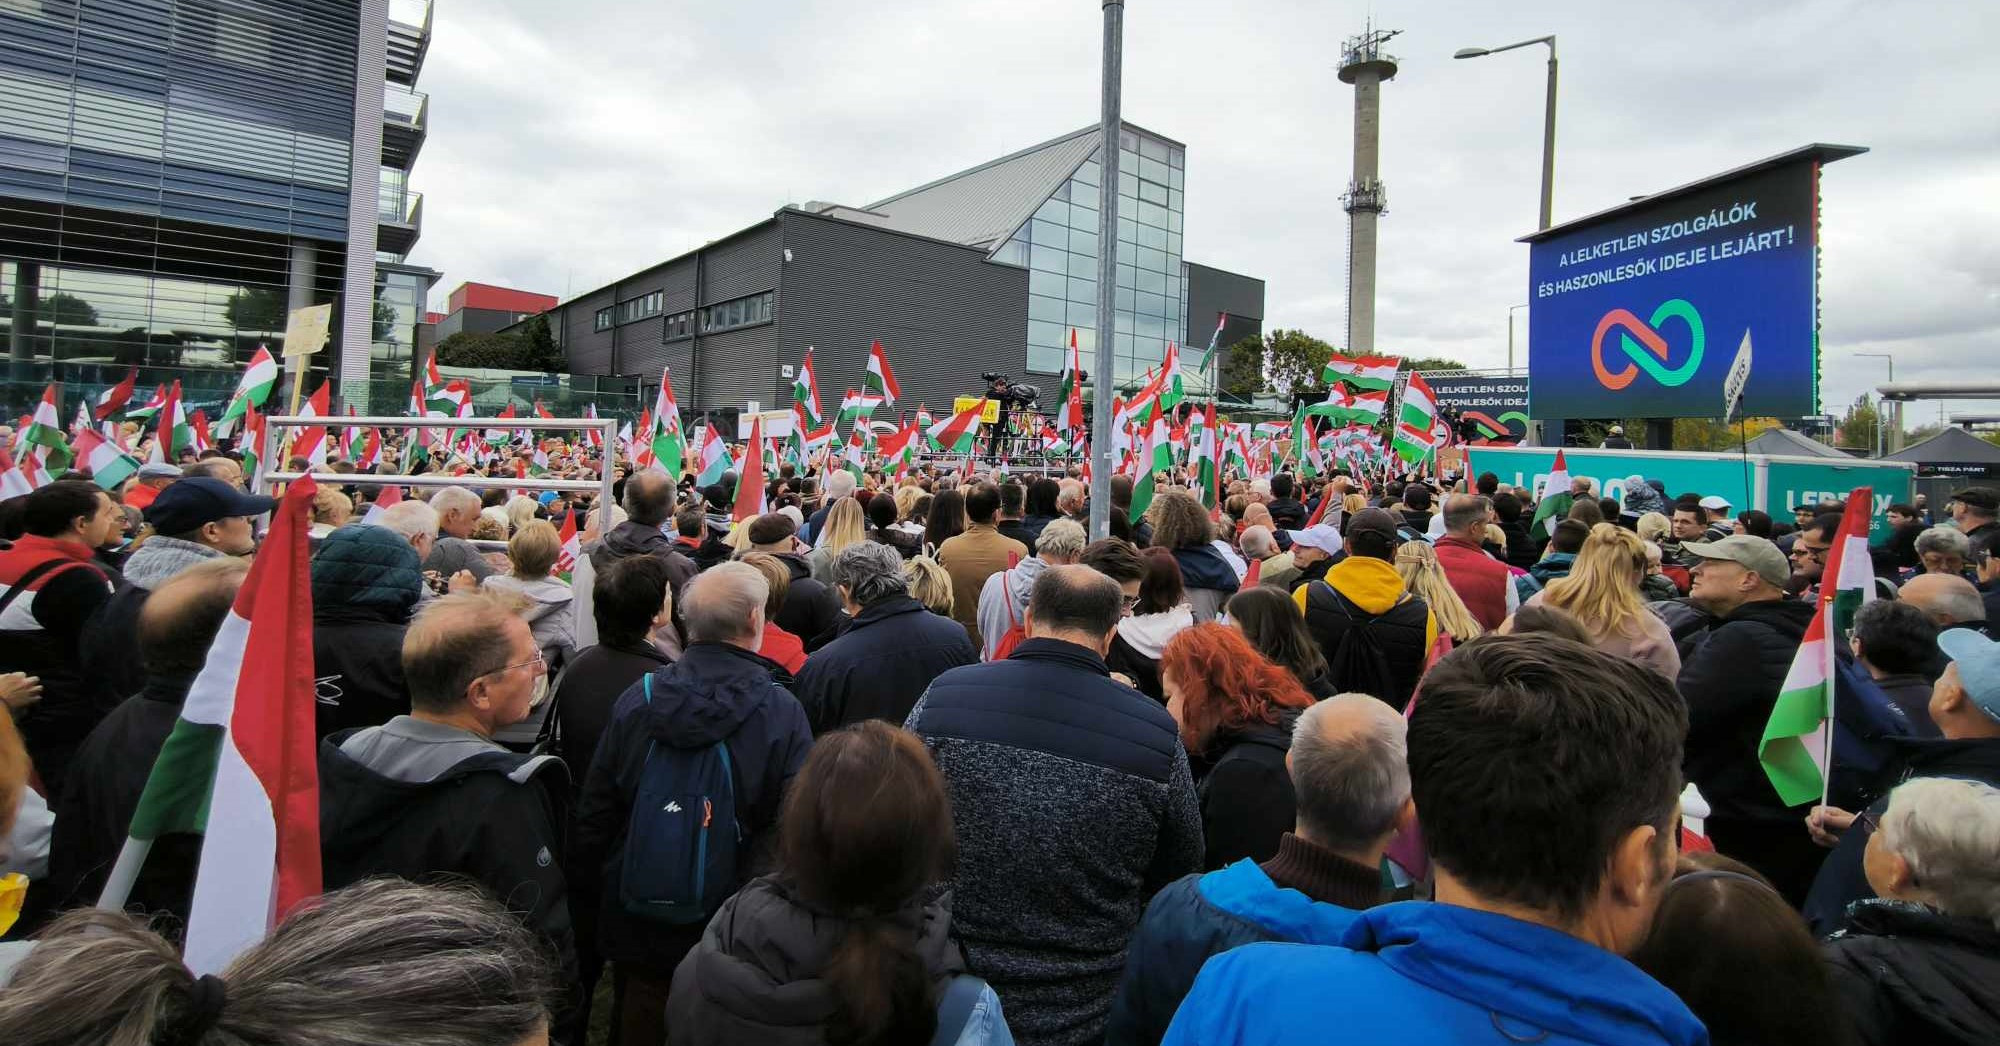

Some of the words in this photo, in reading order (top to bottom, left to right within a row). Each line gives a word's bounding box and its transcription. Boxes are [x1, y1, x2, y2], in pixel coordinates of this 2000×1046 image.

[1560, 253, 1569, 268] A
[1570, 232, 1648, 265] LELKETLEN
[1651, 201, 1757, 244] SZOLGÁLÓK
[1538, 282, 1554, 298] ÉS
[1659, 247, 1707, 272] IDEJE
[1436, 385, 1495, 394] LELKETLEN
[1496, 384, 1529, 393] SZOL
